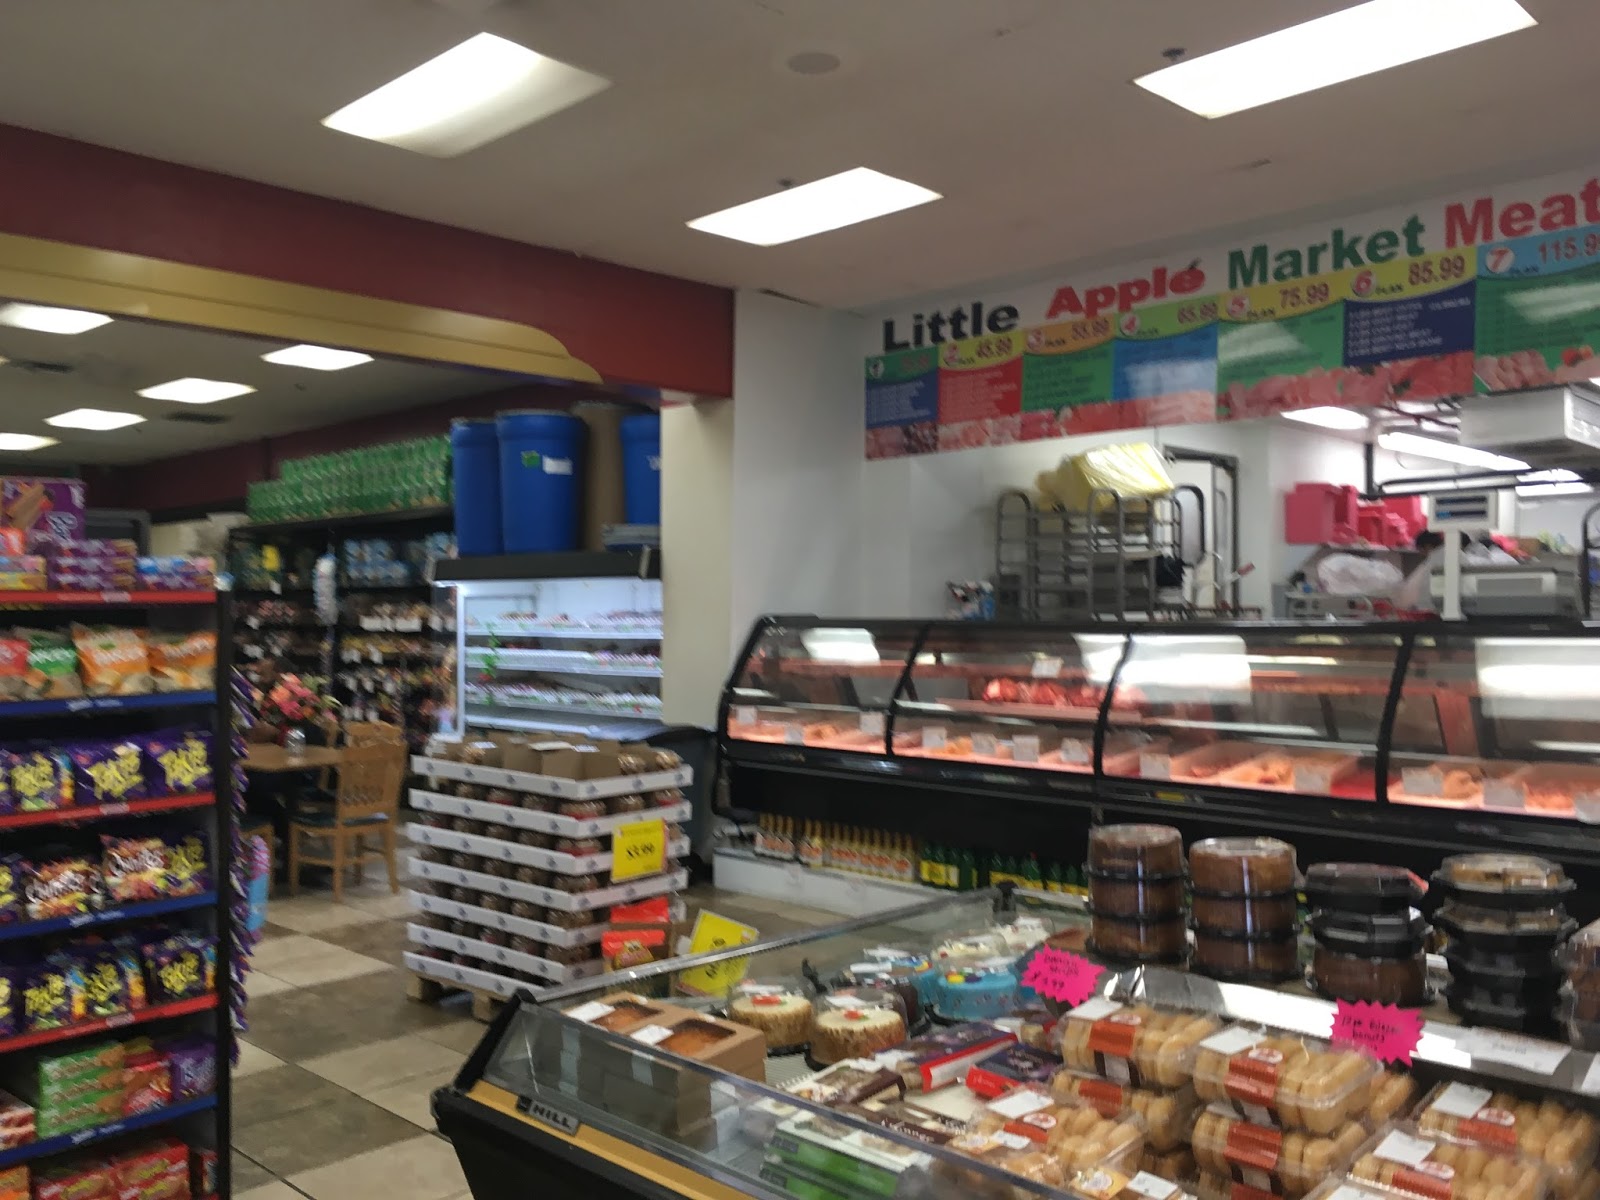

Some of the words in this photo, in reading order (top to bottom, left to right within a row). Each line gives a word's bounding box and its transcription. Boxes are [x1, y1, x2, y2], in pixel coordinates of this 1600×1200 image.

[1490, 248, 1509, 270] 7
[1537, 232, 1600, 264] 115.9
[882, 301, 1019, 351] Little
[1045, 262, 1206, 319] Apple
[1228, 214, 1426, 290] Market
[1354, 269, 1373, 290] 6
[1408, 254, 1465, 286] 85.99
[1279, 283, 1329, 310] 75.99
